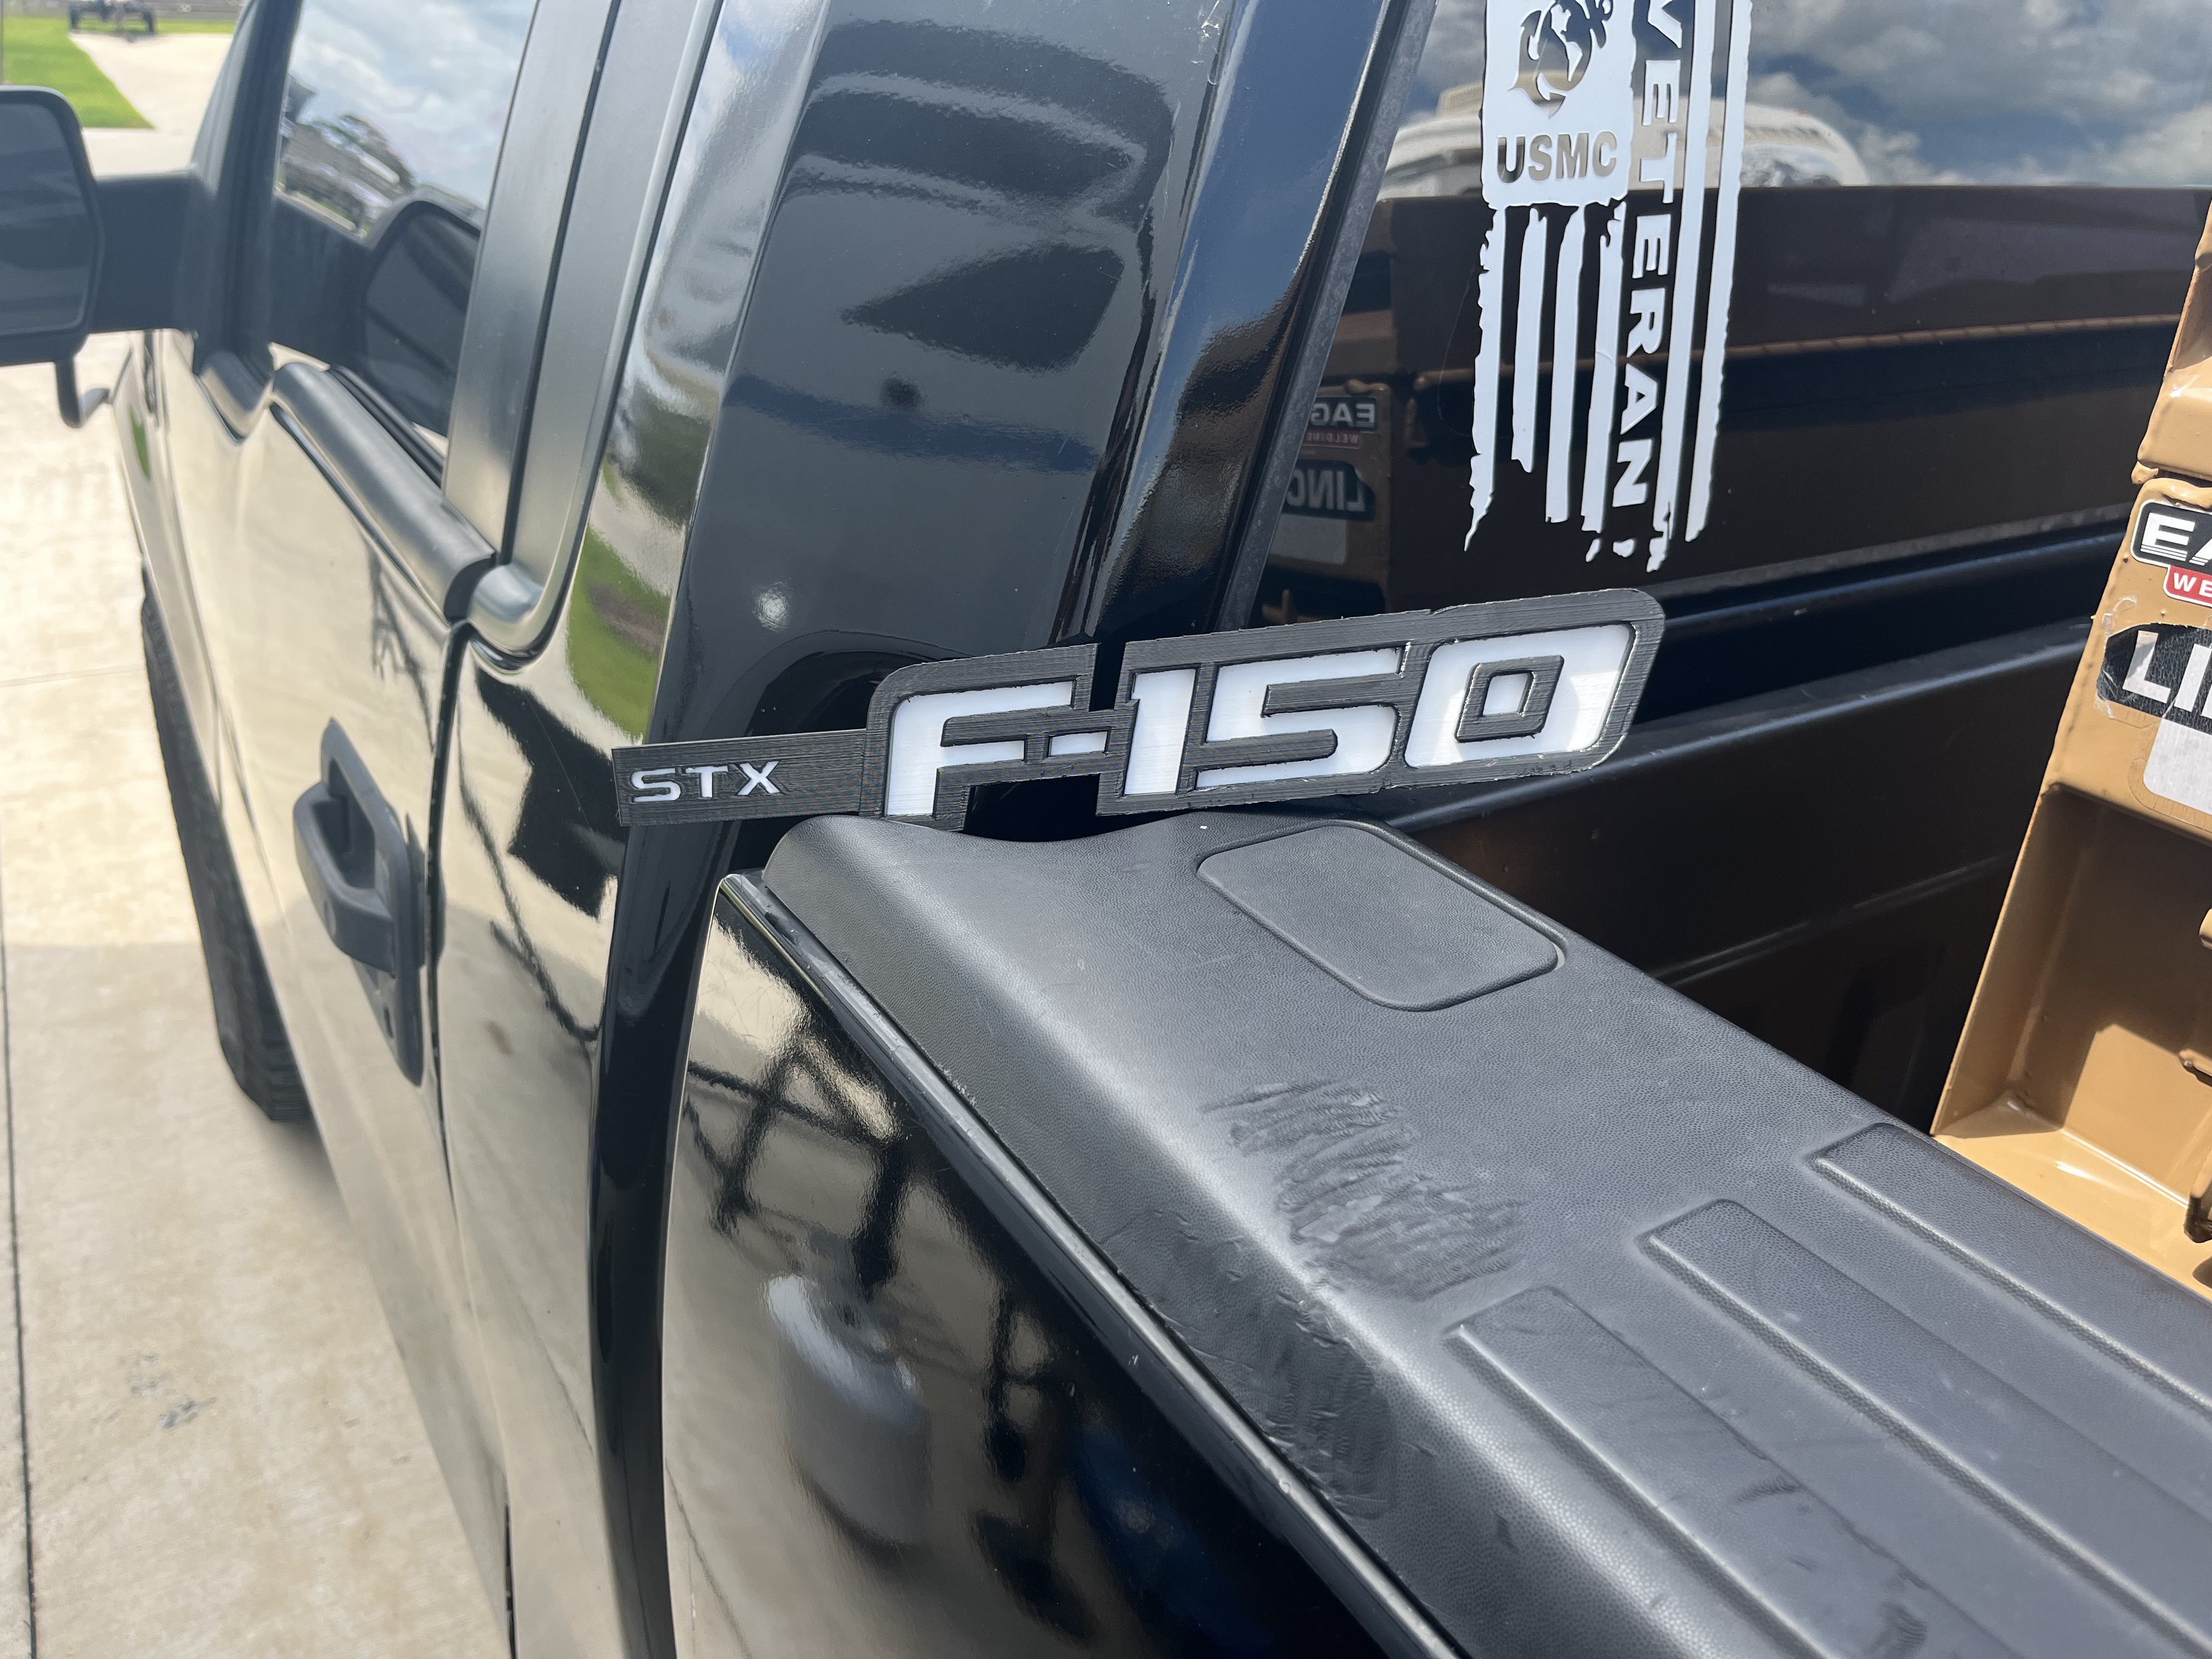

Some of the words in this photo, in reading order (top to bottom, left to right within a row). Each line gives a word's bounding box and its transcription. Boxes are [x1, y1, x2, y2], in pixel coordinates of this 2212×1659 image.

[1496, 130, 1618, 184] USMC
[1612, 0, 1682, 507] VETERAN
[2122, 630, 2212, 719] LI
[885, 624, 1637, 816] F-150
[631, 760, 781, 803] STX
